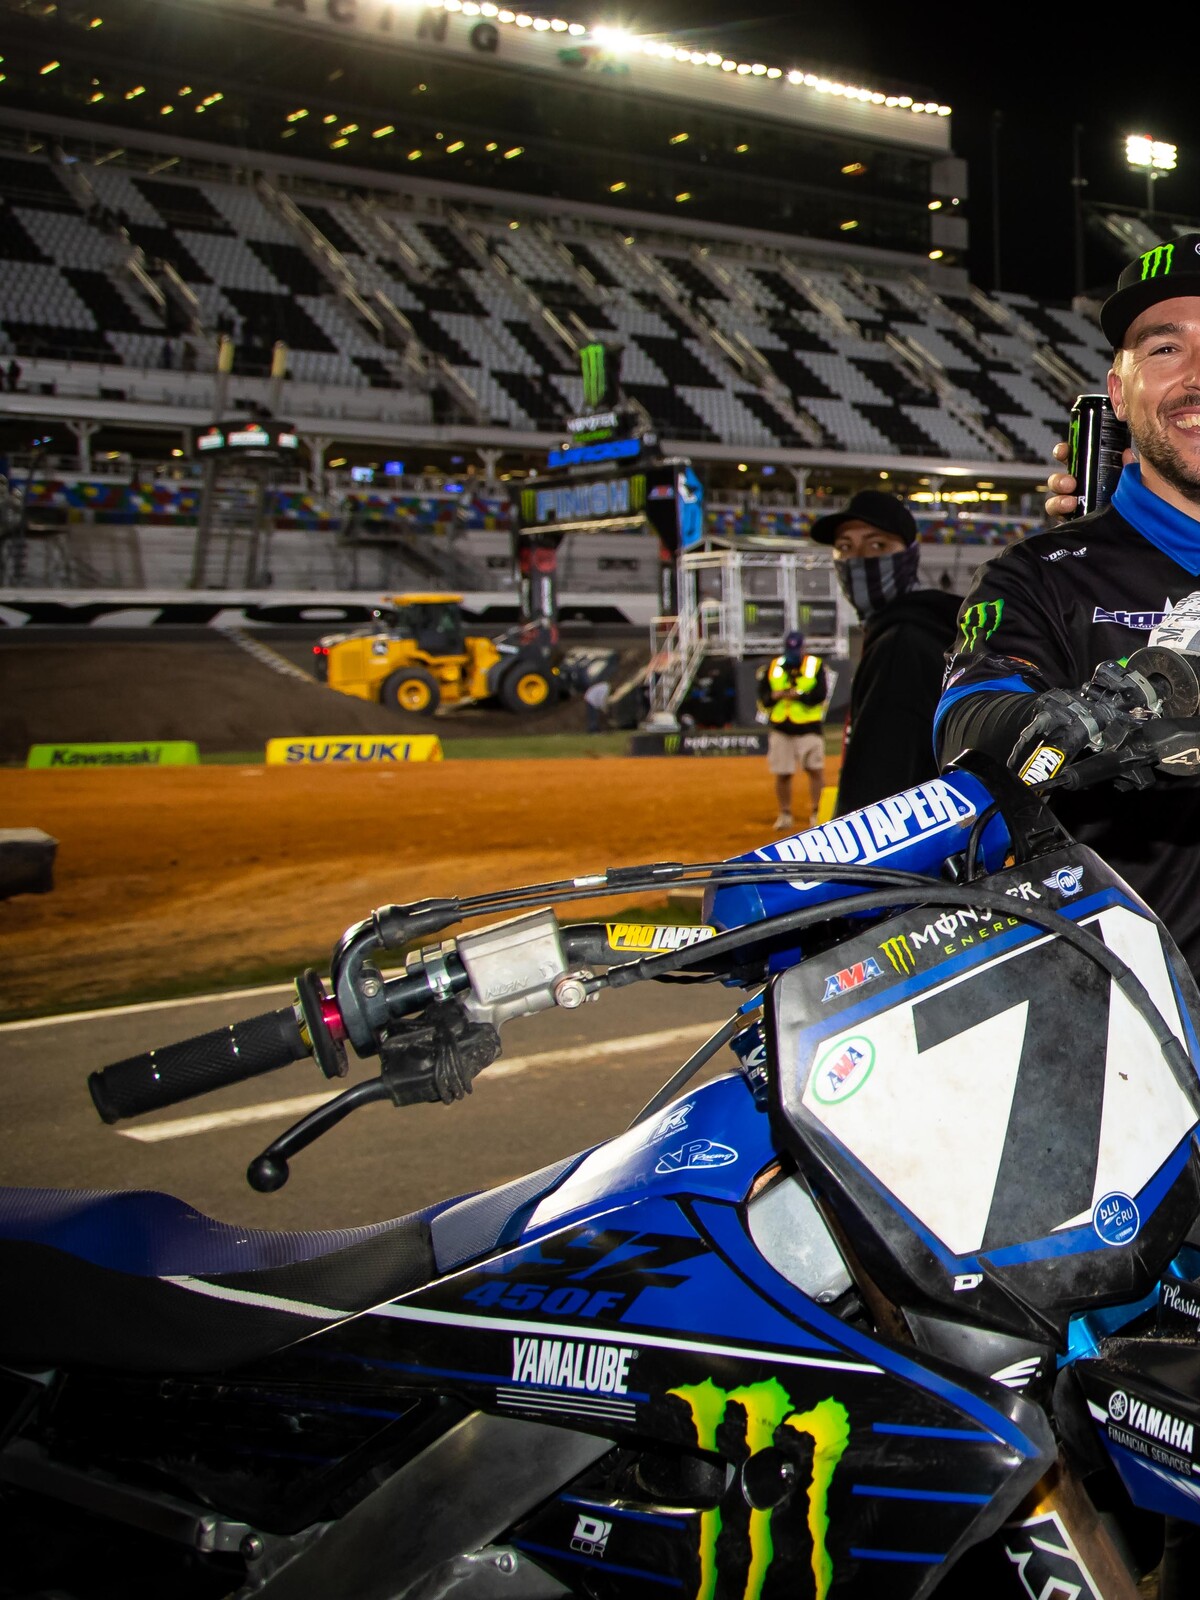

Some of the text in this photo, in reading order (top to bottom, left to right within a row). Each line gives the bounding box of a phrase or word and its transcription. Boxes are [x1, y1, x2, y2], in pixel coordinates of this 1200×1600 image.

[535, 478, 631, 523] FINISH
[51, 749, 162, 766] Kawasaki
[286, 743, 413, 762] SUZUKI
[774, 780, 952, 865] PROTAPER
[1058, 873, 1076, 889] FIM
[821, 956, 885, 1002] AMA
[826, 1046, 864, 1092] AMA
[912, 918, 1112, 1254] 7
[659, 1139, 712, 1171] VP
[1115, 1206, 1133, 1226] CRU
[462, 1280, 627, 1318] 450F
[512, 1337, 633, 1394] YAMALUBE
[1128, 1397, 1194, 1454] YAMAHA
[1108, 1426, 1191, 1476] FINANCIAL SERVICES
